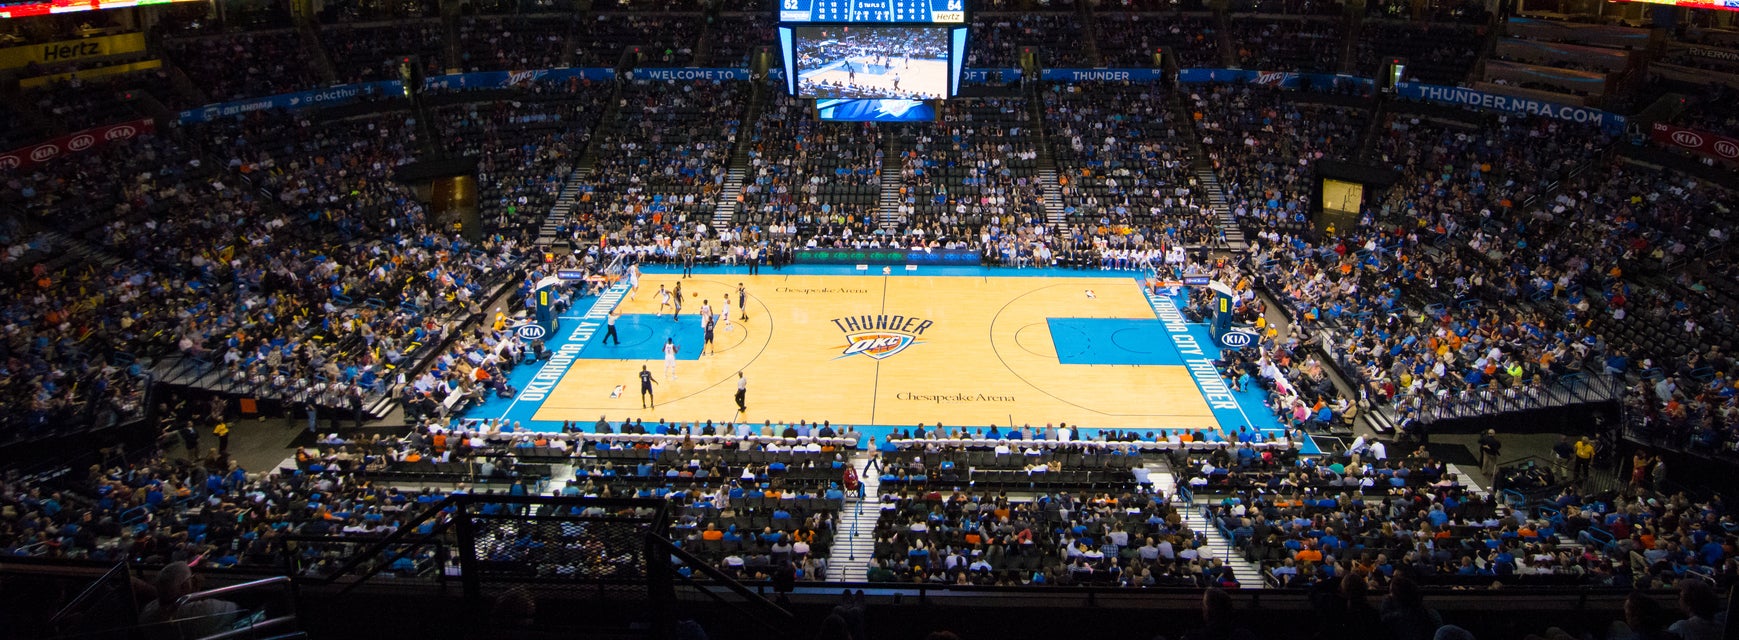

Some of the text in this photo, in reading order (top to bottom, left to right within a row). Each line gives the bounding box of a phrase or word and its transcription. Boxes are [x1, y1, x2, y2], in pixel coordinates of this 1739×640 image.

[936, 13, 960, 21] Hertz
[44, 42, 99, 60] Hertz
[649, 70, 734, 80] WELCOME TO
[980, 71, 1003, 80] TE
[1072, 71, 1130, 81] THUNDER
[1258, 72, 1284, 85] OKC
[1418, 85, 1603, 124] THUNDER.NBA.COM
[108, 128, 131, 139] KIA
[1654, 123, 1668, 131] 120
[71, 136, 91, 149] KIA
[1676, 134, 1698, 145] KIA
[1718, 144, 1736, 156] KIA
[1145, 288, 1188, 332] LAHOMA
[831, 314, 934, 335] THUNDER
[522, 328, 541, 337] KIA
[843, 336, 900, 354] OKC
[1172, 334, 1204, 356] CITY
[1226, 335, 1246, 344] KIA
[519, 343, 585, 401] OKLAHOMA
[568, 321, 601, 341] CITY
[1186, 357, 1237, 409] THUNDER
[896, 391, 1016, 404] Chesapeake Arena
